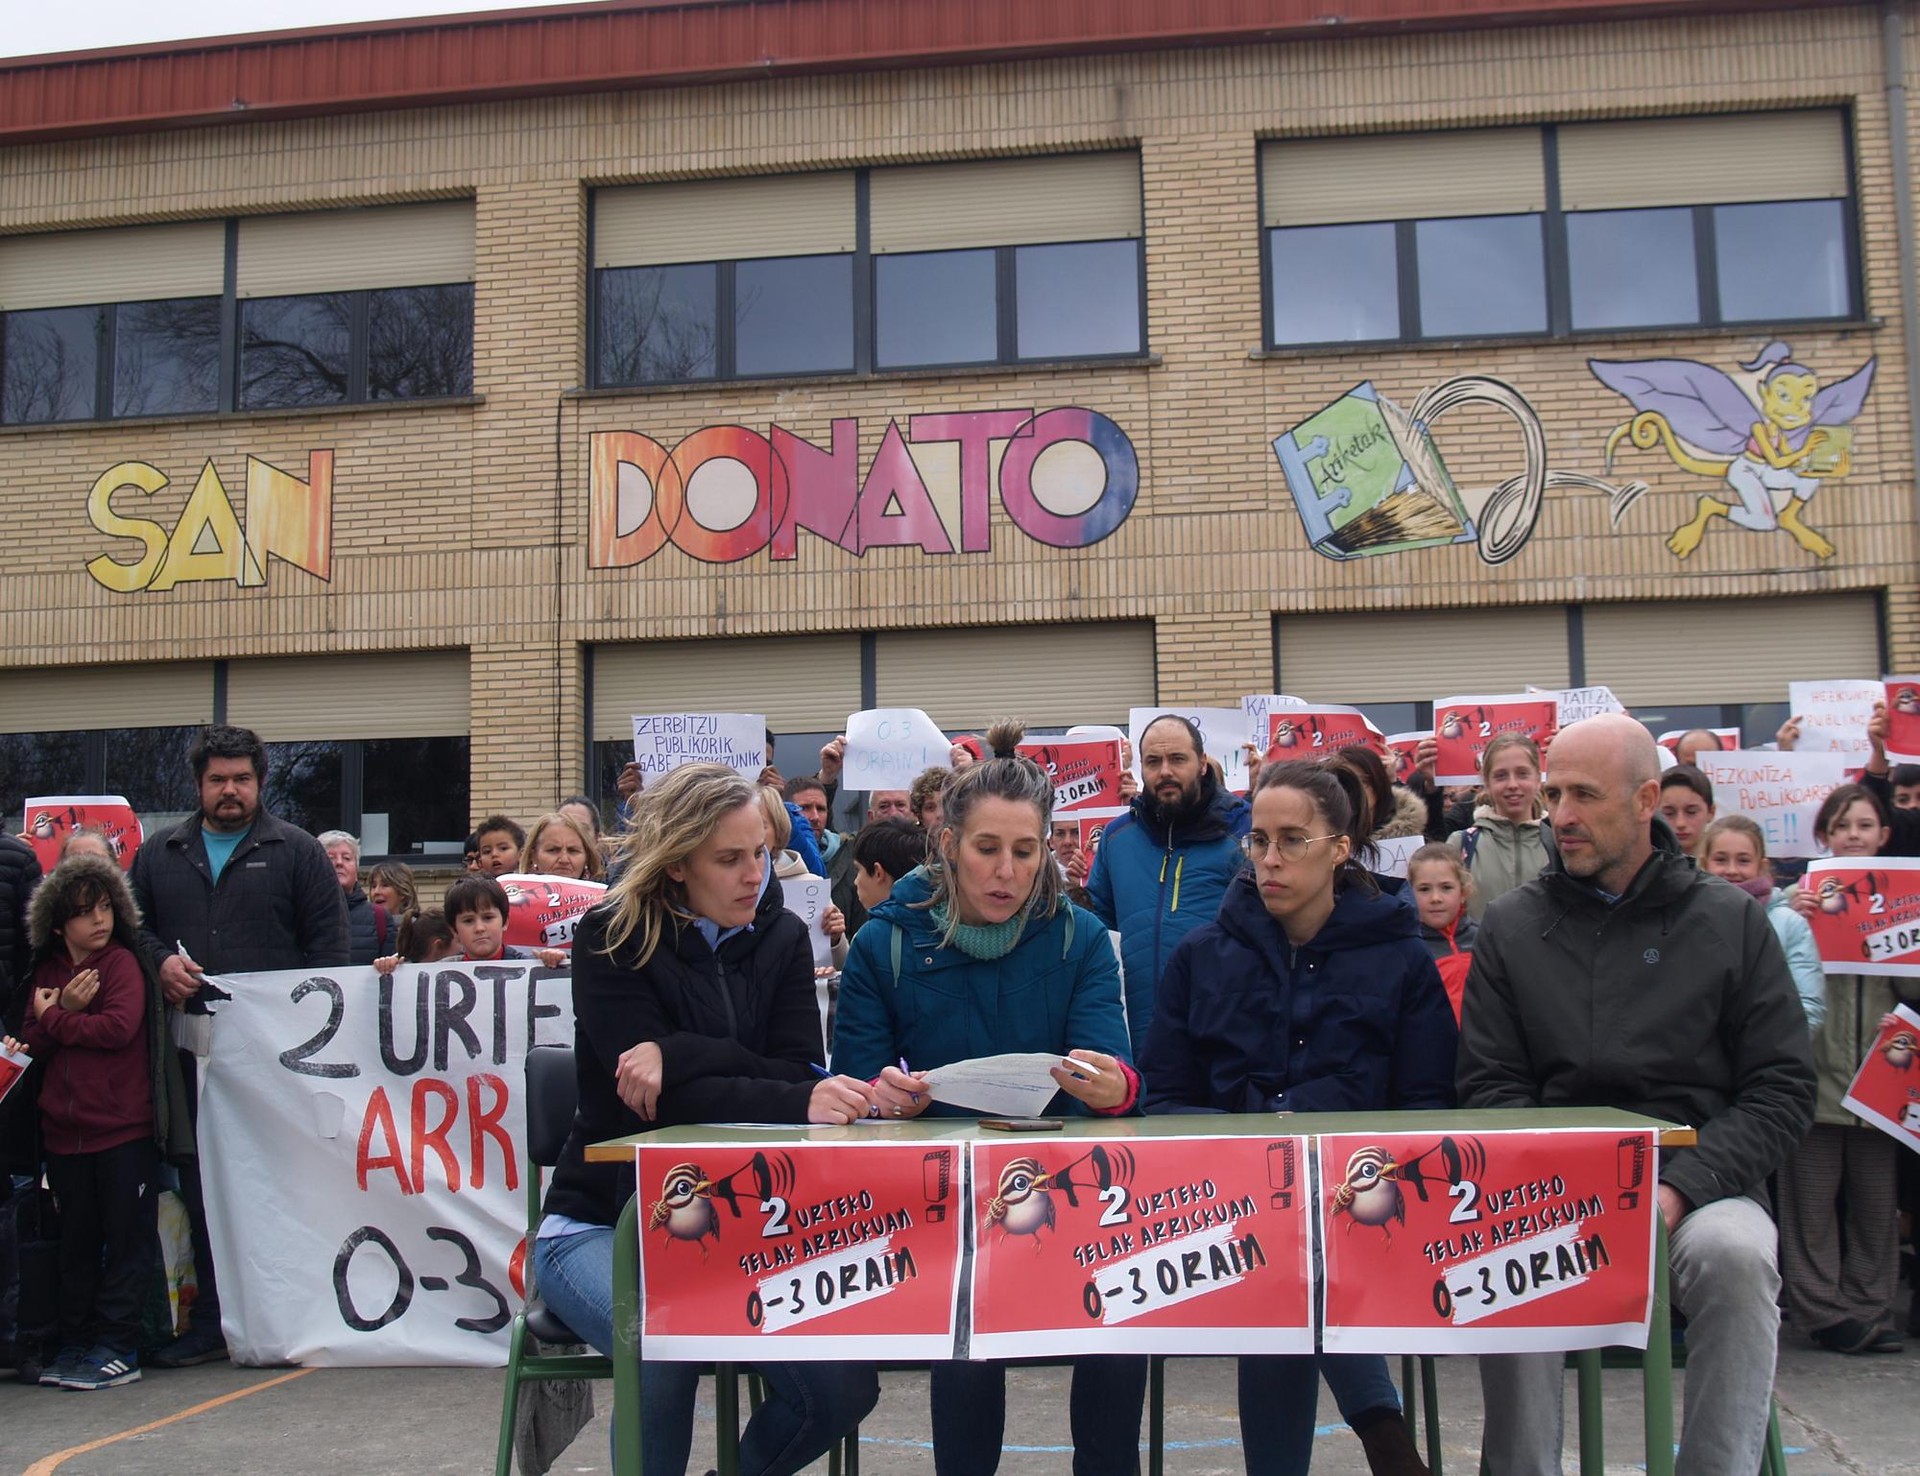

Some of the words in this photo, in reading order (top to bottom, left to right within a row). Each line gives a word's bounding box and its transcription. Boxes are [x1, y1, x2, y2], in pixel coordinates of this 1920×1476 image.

[1318, 410, 1393, 495] Ariketak
[86, 449, 334, 592] SAN
[588, 406, 1140, 569] DONATO
[654, 735, 733, 754] PUBLIKORIK
[1312, 731, 1324, 747] 2
[1479, 721, 1492, 737] 2
[1046, 762, 1058, 777] 2
[1069, 778, 1108, 800] ORAIN
[547, 893, 561, 907] 2
[1868, 893, 1885, 914] 2
[279, 976, 361, 1078] 2
[759, 1196, 793, 1238] 2
[796, 1190, 874, 1229] URTEKO
[1098, 1185, 1132, 1227] 2
[1136, 1179, 1217, 1218] URTEKO
[1141, 1195, 1259, 1247] ARRISKUAN
[1448, 1180, 1482, 1223] 2
[1486, 1175, 1566, 1214] URTEKO
[1491, 1194, 1605, 1246] ARRISKUAN
[803, 1207, 914, 1257] ARRISKUAN
[747, 1279, 804, 1328] 0-3
[816, 1247, 918, 1305] ORAIN
[1083, 1268, 1147, 1319] 0-3
[1156, 1233, 1267, 1296] ORAIN
[1432, 1267, 1497, 1318] 0-3
[1506, 1234, 1610, 1296] ORAIN
